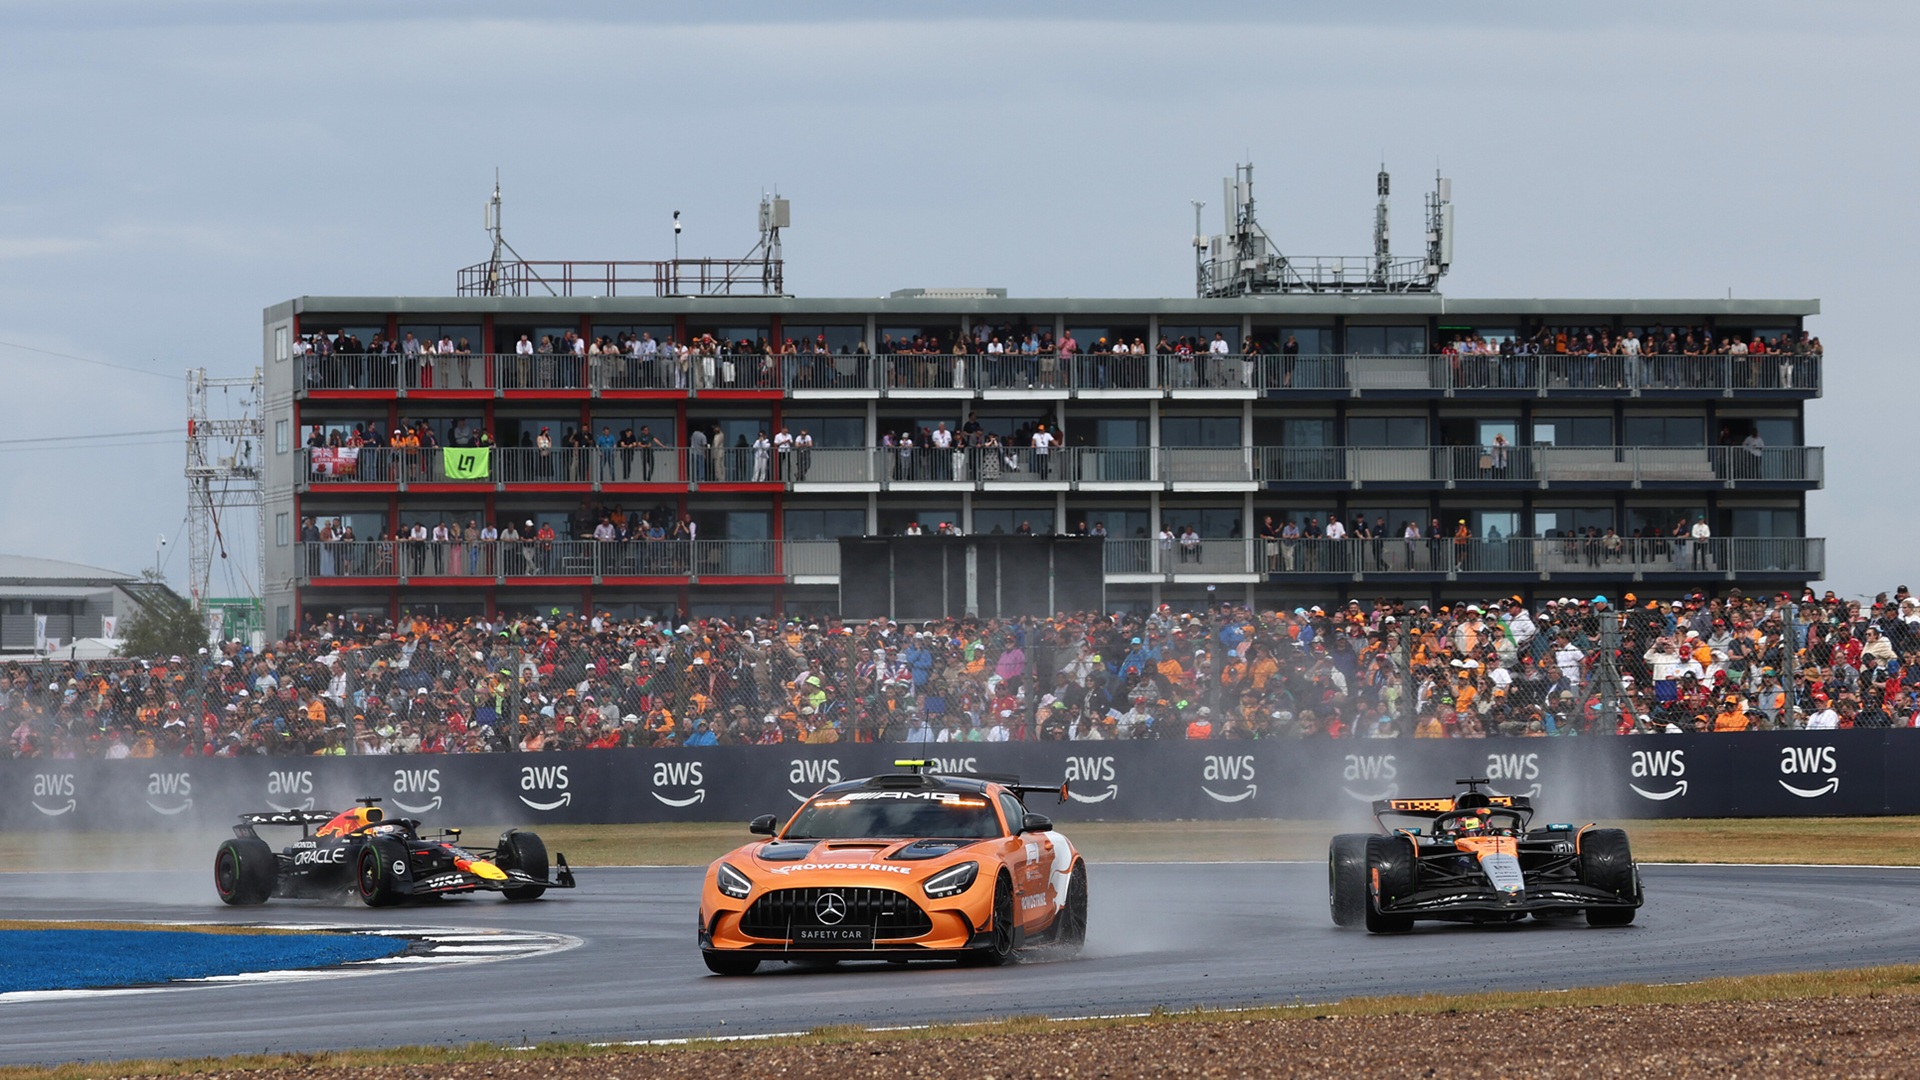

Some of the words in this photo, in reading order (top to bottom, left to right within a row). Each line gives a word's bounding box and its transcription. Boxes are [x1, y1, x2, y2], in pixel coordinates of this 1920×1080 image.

[789, 759, 842, 784] aws
[1065, 756, 1116, 781] aws
[1203, 755, 1256, 781] aws
[1343, 755, 1397, 780] aws
[1486, 753, 1539, 779] aws
[1631, 750, 1685, 777] aws
[1780, 746, 1837, 774] aws
[33, 773, 75, 796] aws
[147, 772, 192, 796] aws
[268, 770, 314, 794] aws
[393, 769, 441, 793] aws
[521, 765, 569, 790] aws
[653, 761, 703, 786] aws
[875, 792, 961, 802] AMG
[292, 841, 317, 849] HONDA
[294, 848, 348, 866] ORACLE
[425, 874, 464, 888] VISA
[771, 863, 912, 875] CROWDSTRIKE
[801, 930, 838, 939] SAFETY
[841, 930, 862, 939] CAR
